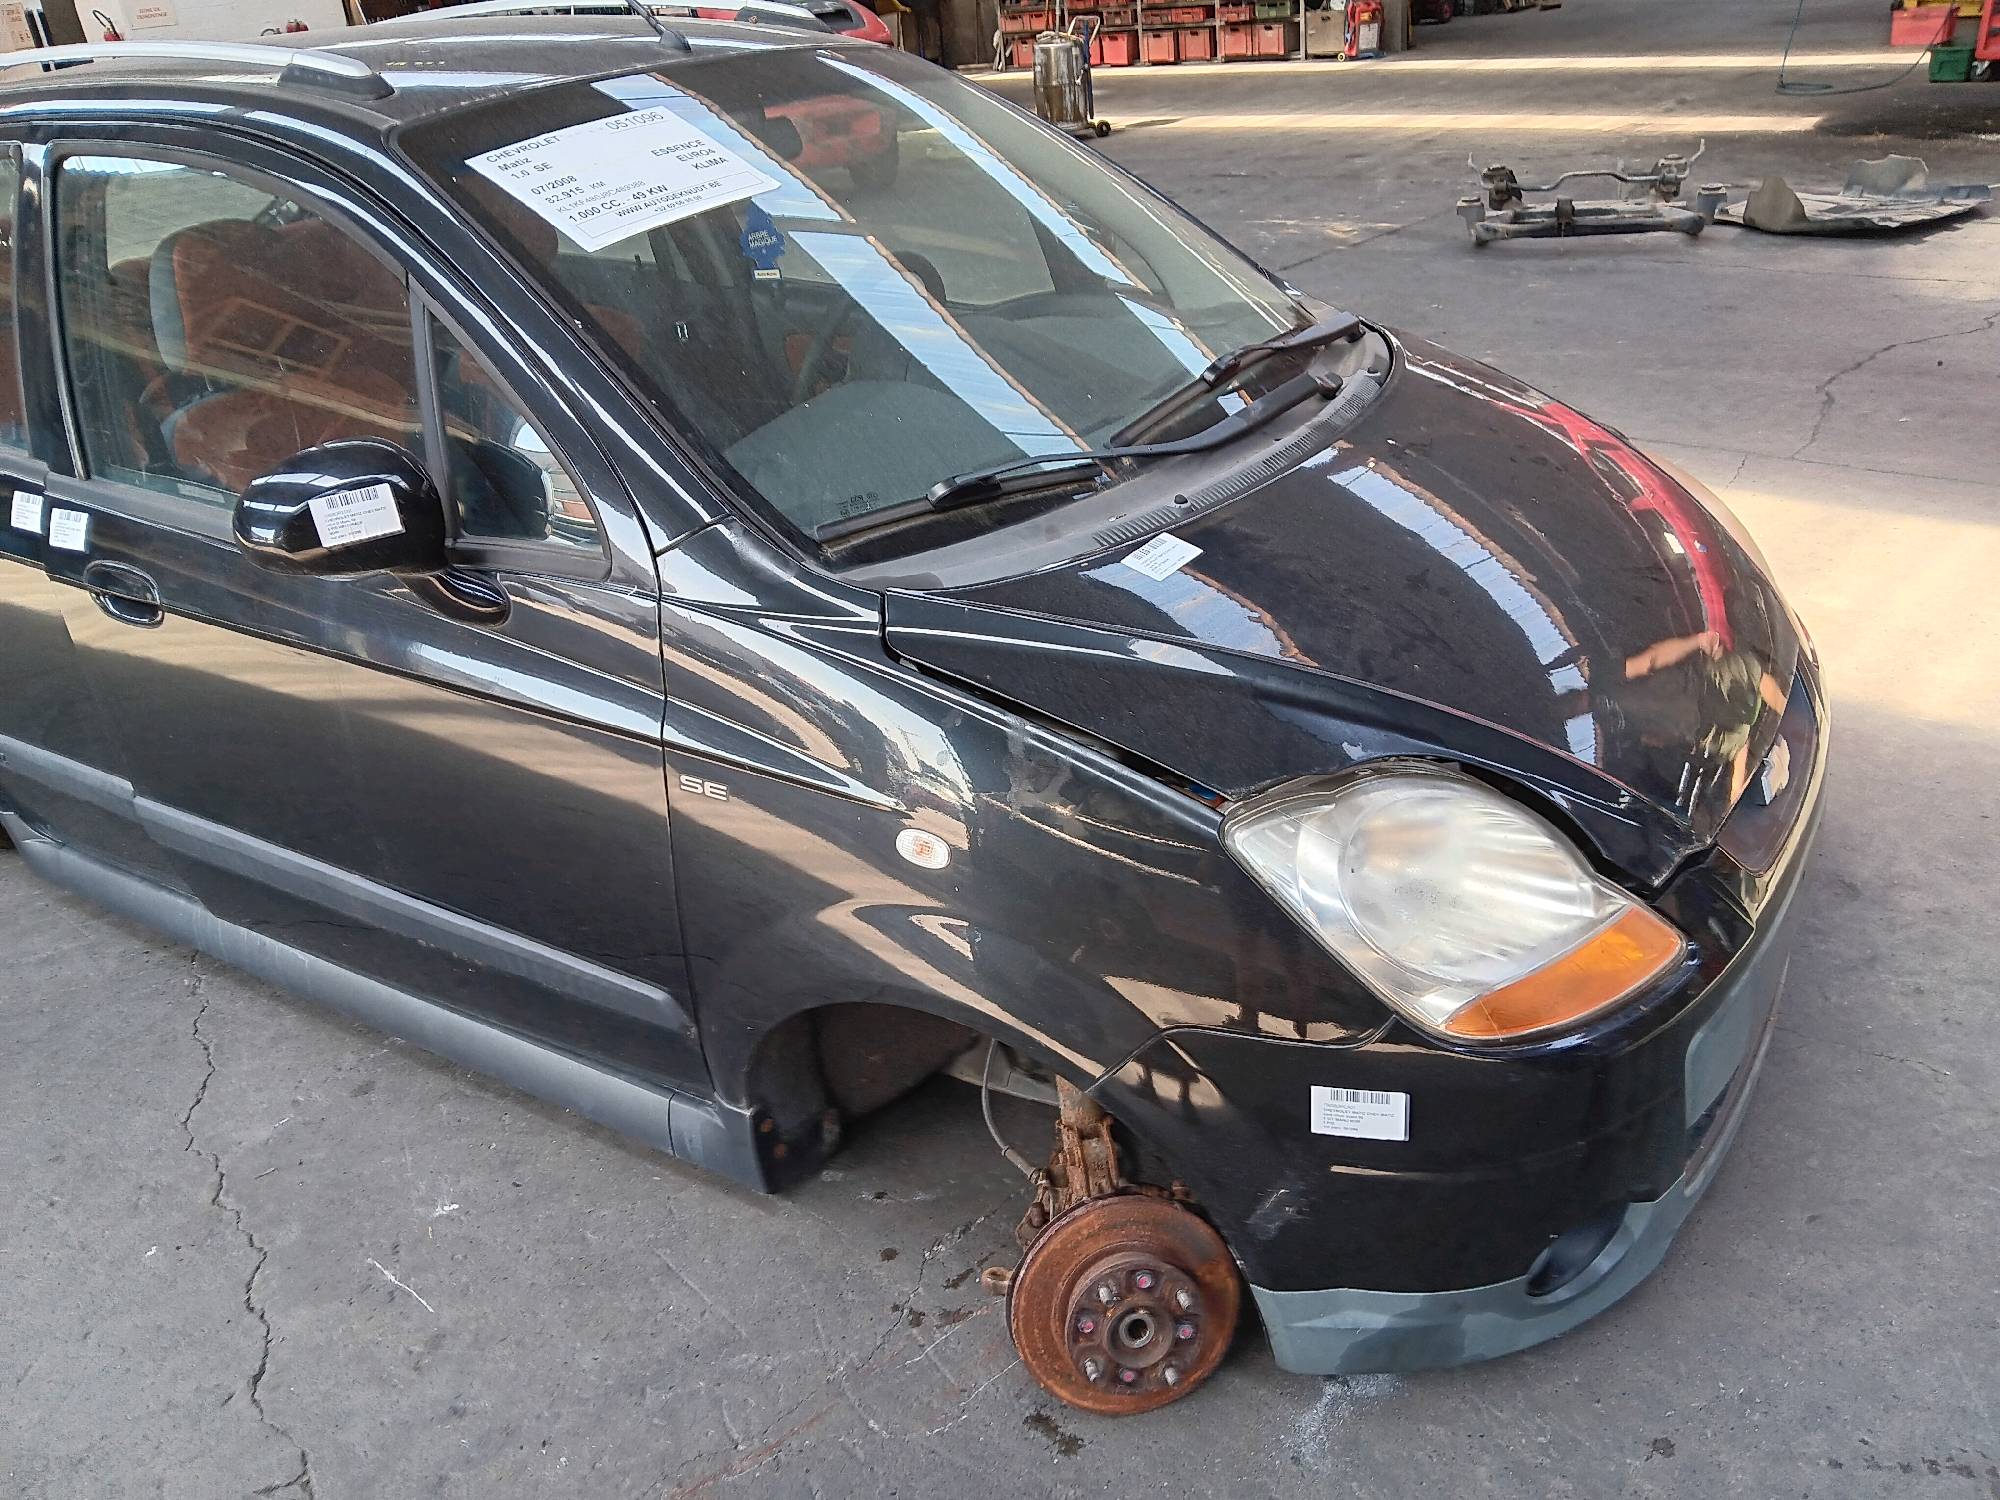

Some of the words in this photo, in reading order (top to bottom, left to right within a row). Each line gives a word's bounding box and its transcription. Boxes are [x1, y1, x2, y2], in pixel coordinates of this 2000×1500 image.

[604, 110, 665, 131] 051096
[486, 135, 561, 163] CHEVROLET
[650, 138, 706, 157] ESSENCE
[675, 148, 717, 162] EURO4
[497, 157, 533, 172] Matiz
[532, 161, 553, 173] SE
[691, 156, 729, 170] KLIMA
[530, 175, 578, 196] 07/2008
[588, 180, 607, 191] KM
[568, 206, 602, 223] 1.000
[632, 190, 648, 201] 49
[646, 184, 669, 196] KW
[679, 774, 728, 802] SE
